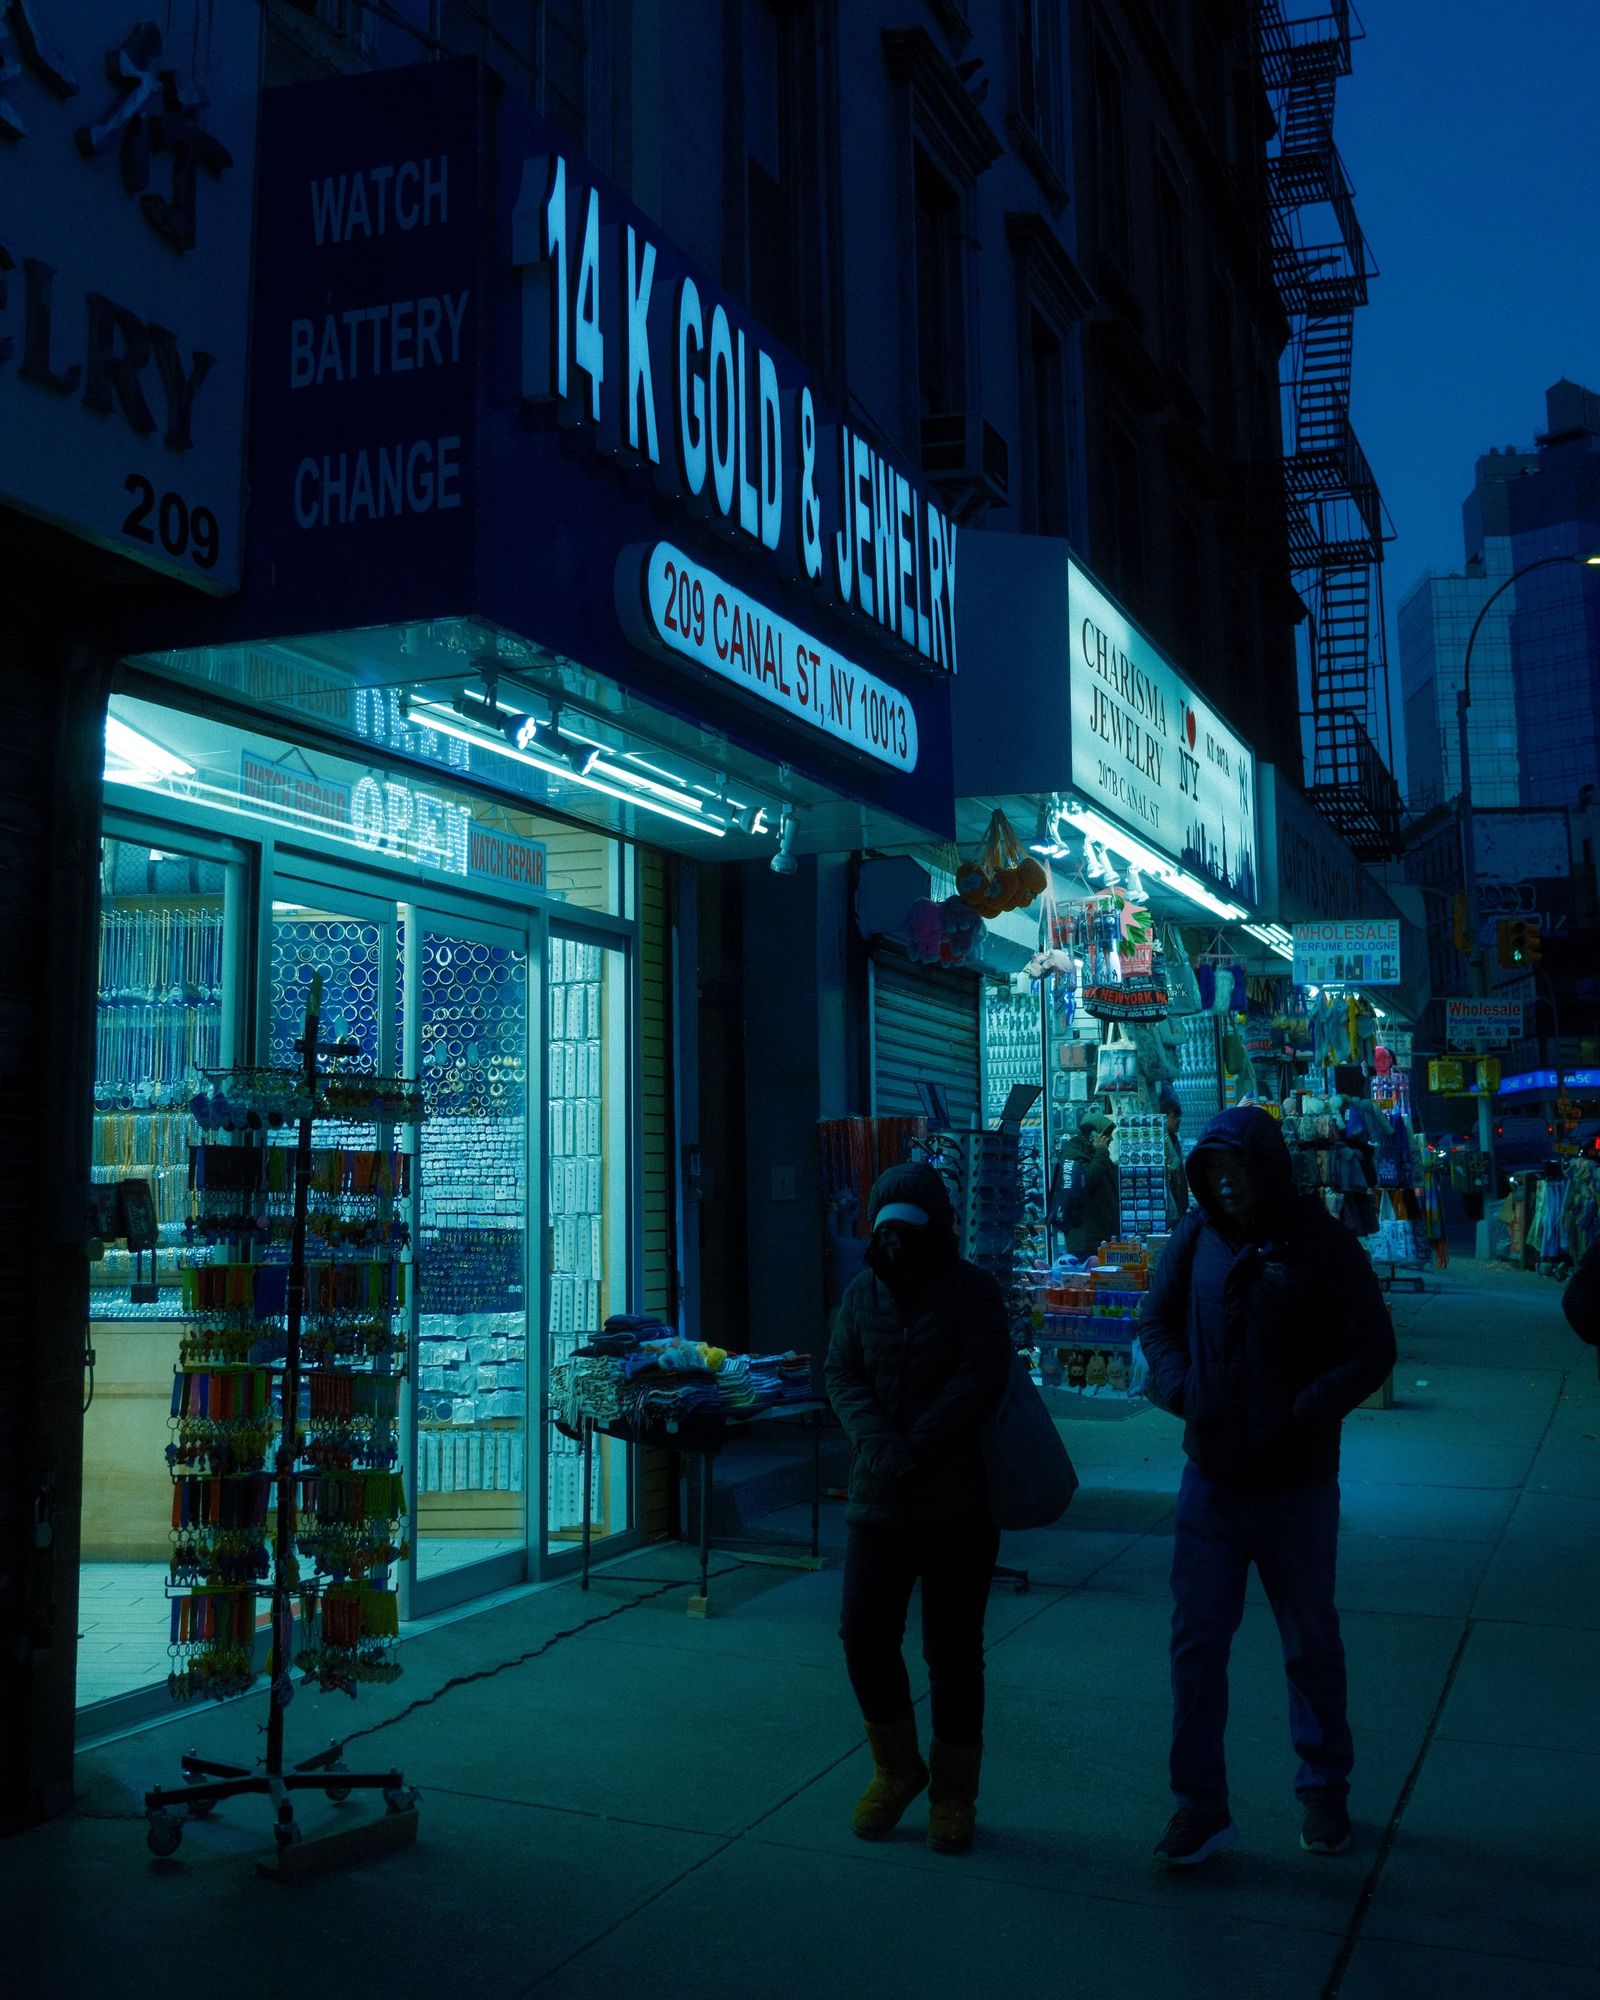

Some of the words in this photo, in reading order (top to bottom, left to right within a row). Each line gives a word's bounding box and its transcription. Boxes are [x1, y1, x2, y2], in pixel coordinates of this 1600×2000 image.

[310, 154, 449, 247] WATCH
[289, 290, 471, 390] BATTERY
[547, 154, 604, 422] 14
[625, 223, 660, 466] K
[678, 276, 783, 551] GOLD
[801, 386, 822, 579] &
[834, 424, 958, 675] JEWELRY
[121, 473, 219, 569] 209
[293, 434, 462, 530] CHANGE
[664, 561, 705, 647] 209
[713, 593, 790, 697] CANAL
[861, 684, 907, 759] 10013
[1082, 617, 1167, 737] CHARISMA
[1090, 683, 1164, 787] JEWELRY
[1179, 698, 1186, 744] I
[1098, 759, 1118, 797] 207B
[1119, 777, 1149, 821] CANAL
[1150, 798, 1160, 829] ST
[1178, 746, 1200, 802] NY
[351, 775, 472, 877] OPEN
[470, 830, 503, 877] WATCH
[506, 841, 543, 887] REPAIR
[1295, 924, 1398, 941] WHOLESALE
[1450, 1002, 1520, 1016] Wholesale
[1106, 1251, 1143, 1264] HOTHANDS
